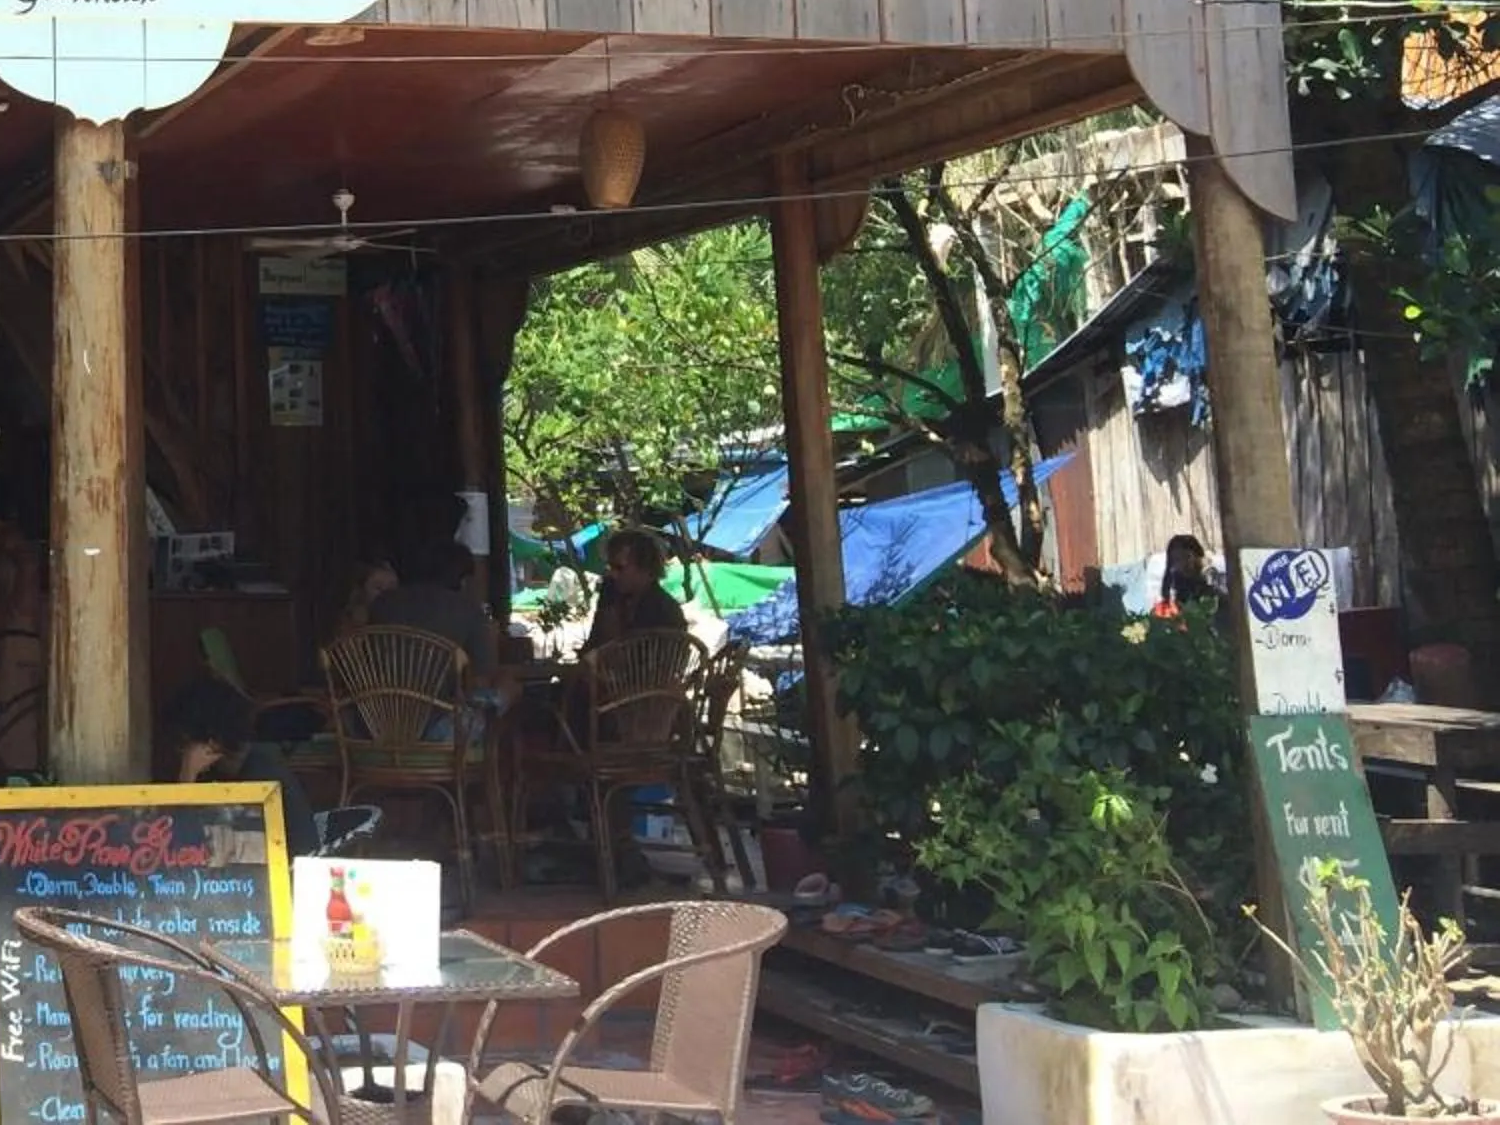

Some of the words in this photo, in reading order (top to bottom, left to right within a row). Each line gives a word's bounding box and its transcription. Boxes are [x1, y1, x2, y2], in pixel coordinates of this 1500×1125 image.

[1268, 554, 1289, 575] FREE
[1266, 723, 1349, 774] Tents
[1313, 801, 1350, 838] rent
[158, 909, 198, 933] color
[210, 910, 261, 935] inside
[0, 939, 23, 1003] WiFi
[0, 1009, 24, 1063] Free
[139, 992, 164, 1030] for
[173, 998, 244, 1048] reading
